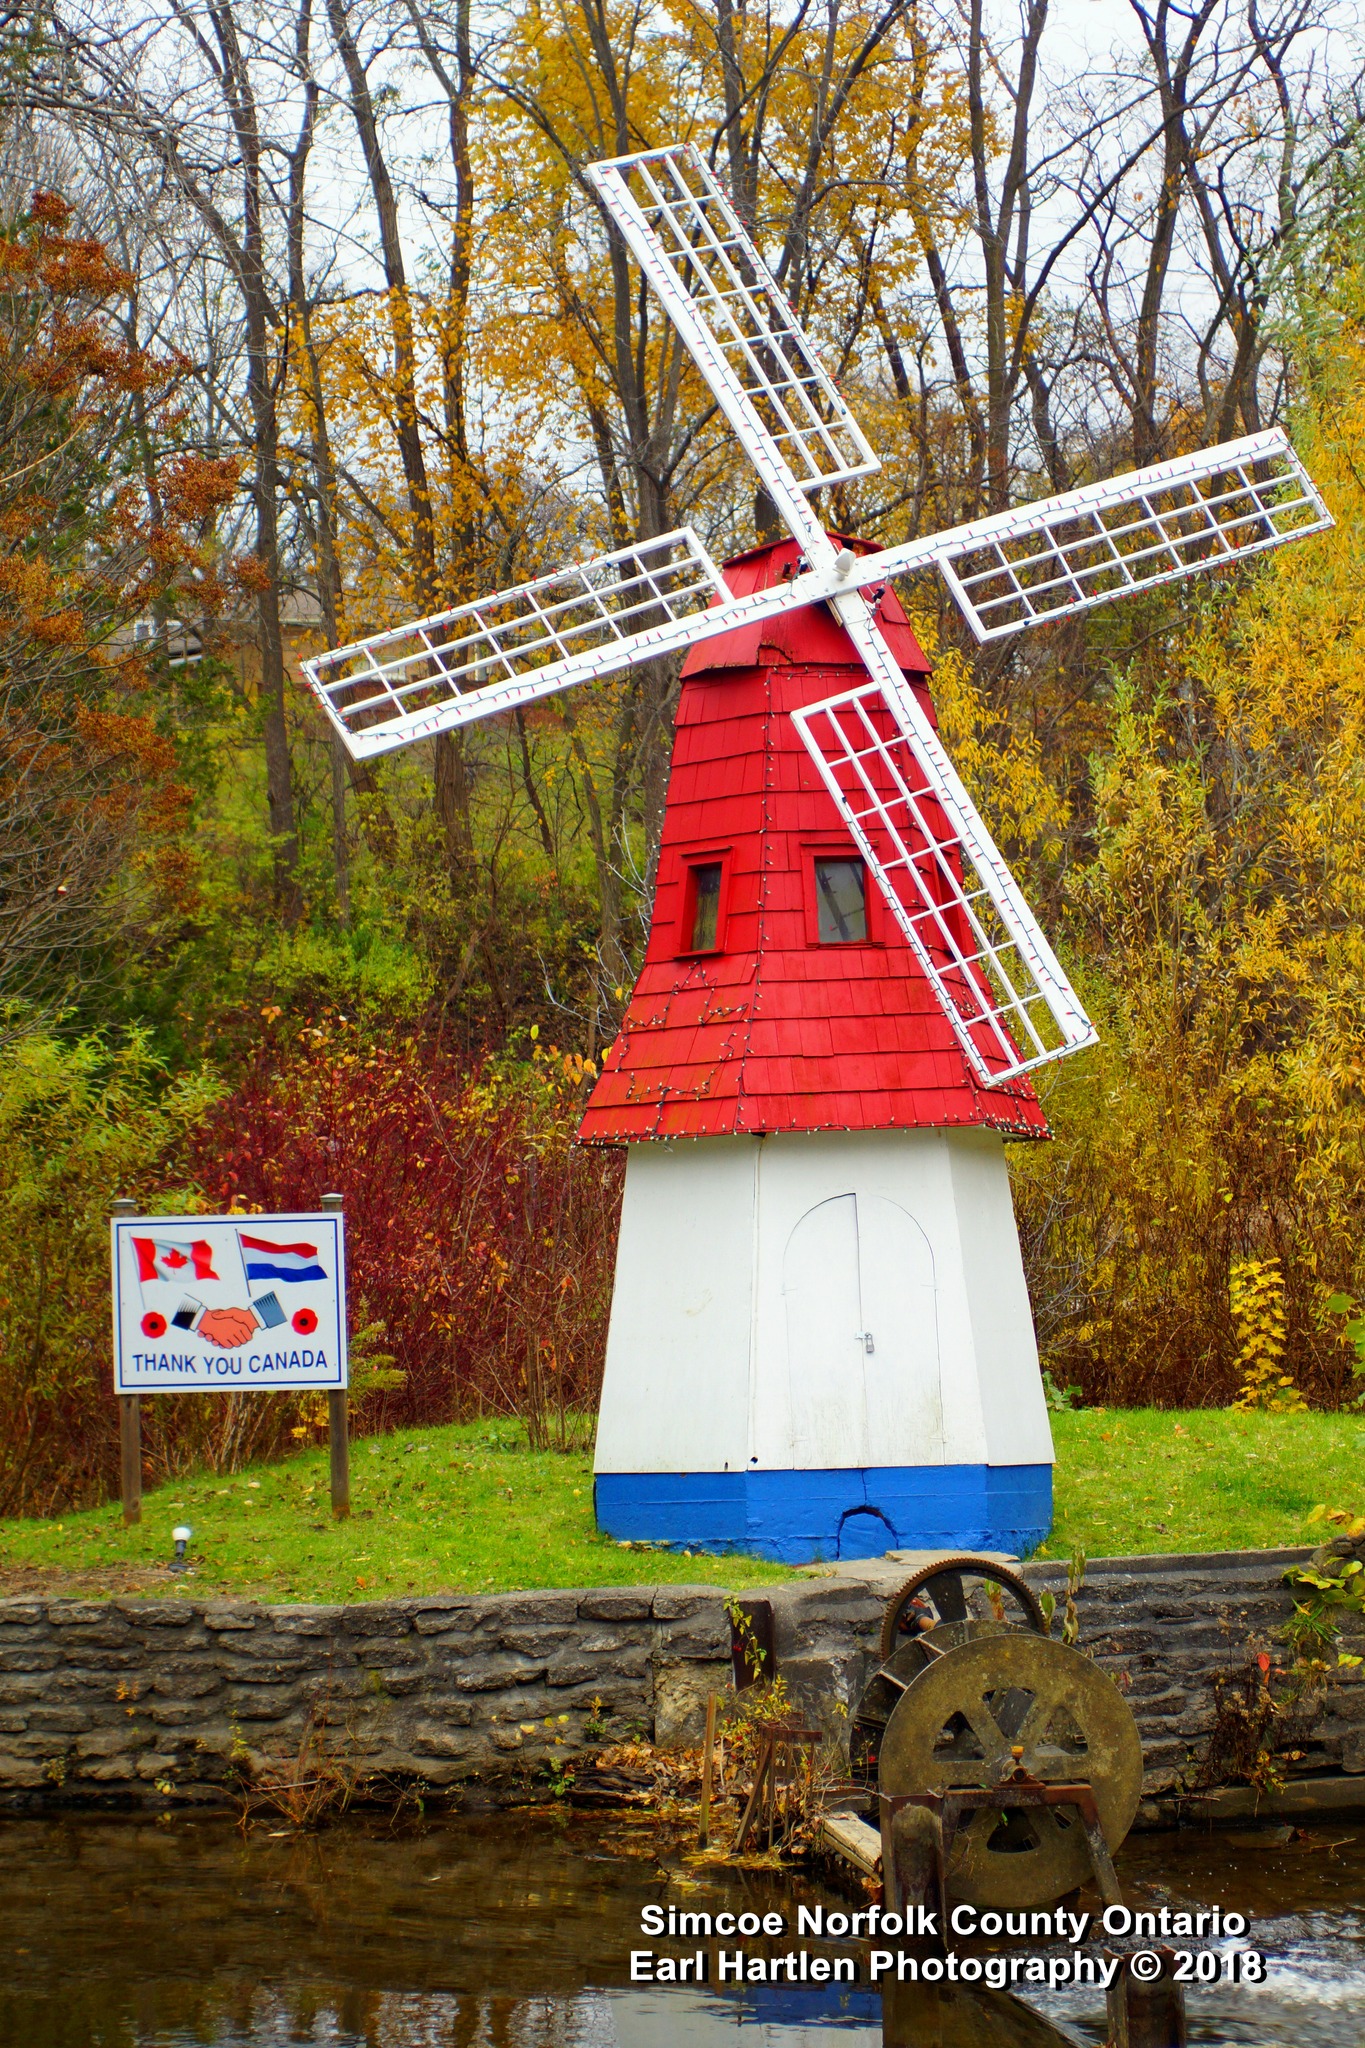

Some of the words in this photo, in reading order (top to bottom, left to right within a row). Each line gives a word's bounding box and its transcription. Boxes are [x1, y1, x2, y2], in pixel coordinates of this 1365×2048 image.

[132, 1353, 197, 1374] THANK
[203, 1356, 242, 1375] YOU
[248, 1350, 328, 1373] CANADA
